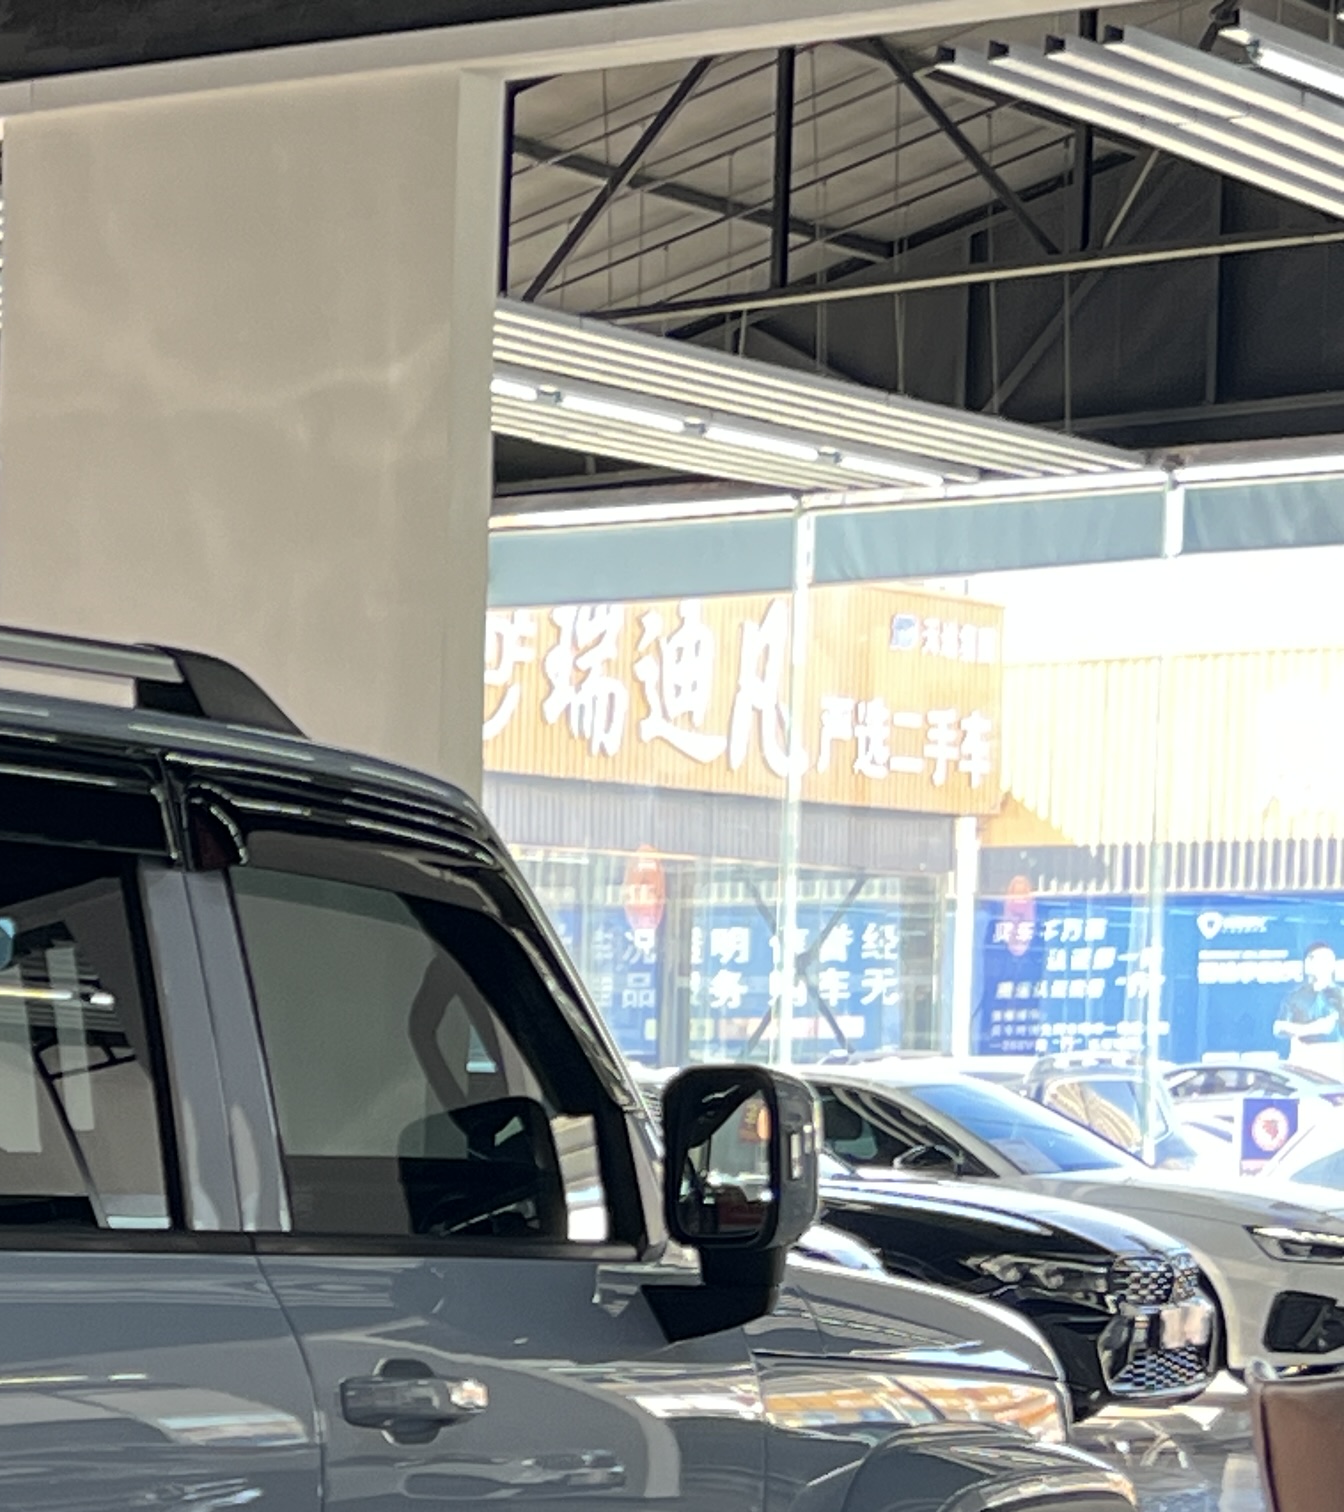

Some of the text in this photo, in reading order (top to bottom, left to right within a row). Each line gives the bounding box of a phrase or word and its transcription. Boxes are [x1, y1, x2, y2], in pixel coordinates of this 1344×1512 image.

[817, 694, 993, 790] 严选二手车
